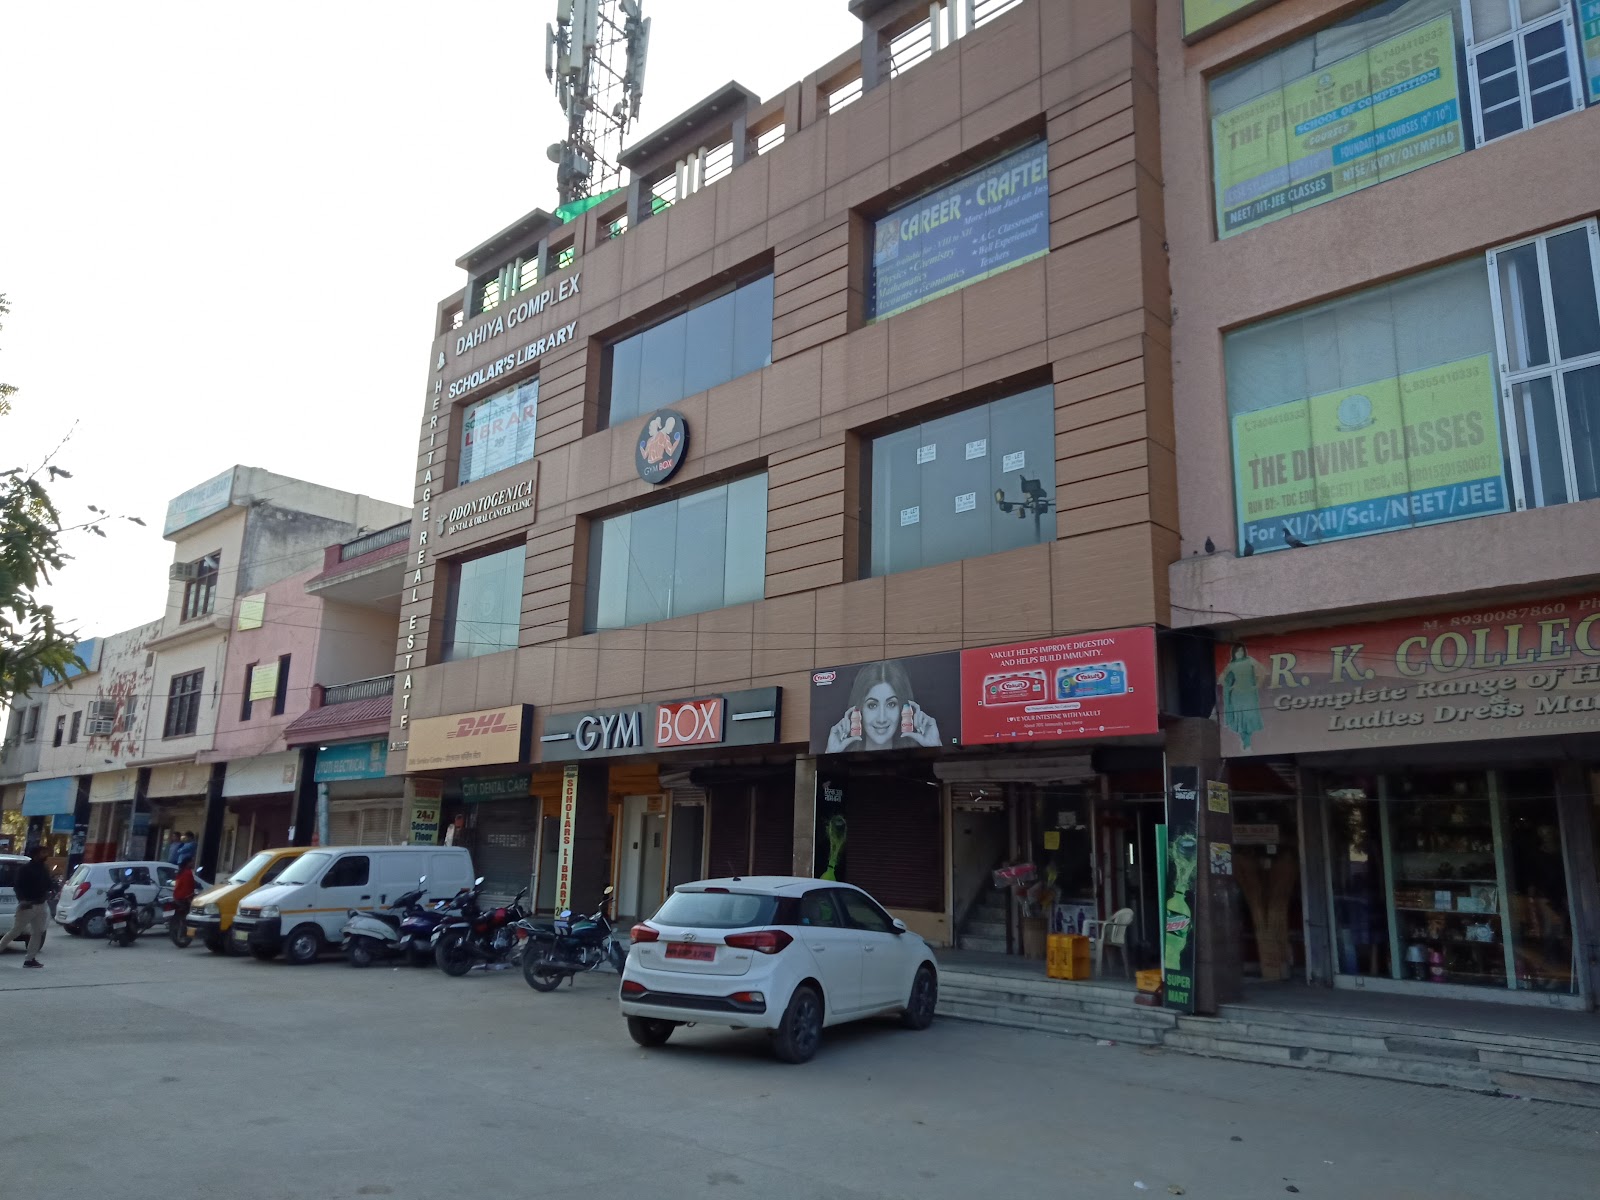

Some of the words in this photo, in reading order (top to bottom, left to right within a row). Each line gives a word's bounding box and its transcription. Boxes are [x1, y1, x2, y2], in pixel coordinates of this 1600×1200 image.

[1228, 119, 1266, 150] THE
[1267, 91, 1335, 134] DIVINE
[1339, 47, 1440, 103] CLASSES
[1296, 110, 1340, 134] SCHOOL
[1340, 105, 1356, 117] OF
[1357, 69, 1438, 109] COMPETITION
[1309, 124, 1348, 146] COURSES
[1340, 134, 1385, 159] FOUNDATION
[1386, 120, 1419, 147] COURSES
[1287, 177, 1327, 201] CLASSES
[900, 194, 961, 241] CAREER
[964, 213, 983, 226] More
[984, 204, 1001, 218] than
[1003, 195, 1021, 210] Just
[997, 210, 1045, 236] Classrooms
[995, 224, 1038, 250] Experienced
[878, 265, 907, 286] Physics
[913, 247, 956, 272] Chemistry
[980, 250, 1010, 268] Teachers
[878, 271, 928, 299] Mathematics
[918, 268, 965, 294] Economics
[456, 315, 505, 356] DAHIYA
[507, 272, 581, 329] COMPLEX
[448, 353, 515, 399] SCHOLAR'S
[516, 320, 577, 367] LIBRARY
[422, 379, 443, 522] HERITAGE
[1248, 455, 1288, 491] THE
[1292, 436, 1370, 482] DIVINE
[1372, 409, 1485, 465] CLASSES
[644, 464, 659, 477] GYM
[658, 458, 674, 471] BOX
[449, 479, 534, 524] ODONTOGENICA
[448, 515, 468, 535] DENTAL
[488, 505, 511, 522] CANCER
[511, 497, 534, 512] CLINIC
[1248, 525, 1276, 544] For
[412, 530, 428, 603] REAL
[1451, 602, 1567, 626] 8930087860
[990, 649, 1016, 659] YAKULT
[1016, 647, 1039, 656] HELPS
[1039, 643, 1072, 654] IMPROVE
[1073, 638, 1115, 649] DIGESTION
[1000, 659, 1016, 667] AND
[1016, 656, 1039, 666] HELPS
[1039, 653, 1062, 663] BUILD
[1062, 649, 1104, 660] IMMUNITY.
[400, 615, 418, 731] ESTATE
[1080, 671, 1101, 680] Yakult
[1268, 652, 1310, 690] R.
[1329, 643, 1376, 685] K.
[1004, 681, 1024, 690] Yakult
[1273, 685, 1407, 711] Complete
[1415, 674, 1517, 699] Range
[1527, 667, 1567, 691] of
[456, 712, 509, 739] DHL
[575, 710, 643, 751] GYM
[657, 698, 718, 744] BOX
[1062, 711, 1077, 719] WITH
[1077, 709, 1102, 717] YAKULT
[1327, 710, 1424, 732] Ladies
[1433, 699, 1525, 724] Dress
[463, 783, 479, 797] CITY
[480, 781, 506, 795] DENTAL
[507, 778, 528, 792] CARE
[563, 779, 574, 844] SCHOLARS
[411, 821, 438, 832] Second
[415, 831, 433, 842] Floor
[559, 848, 569, 907] LIBRARY
[1166, 974, 1191, 989] SUPER
[1168, 987, 1188, 1004] MART
